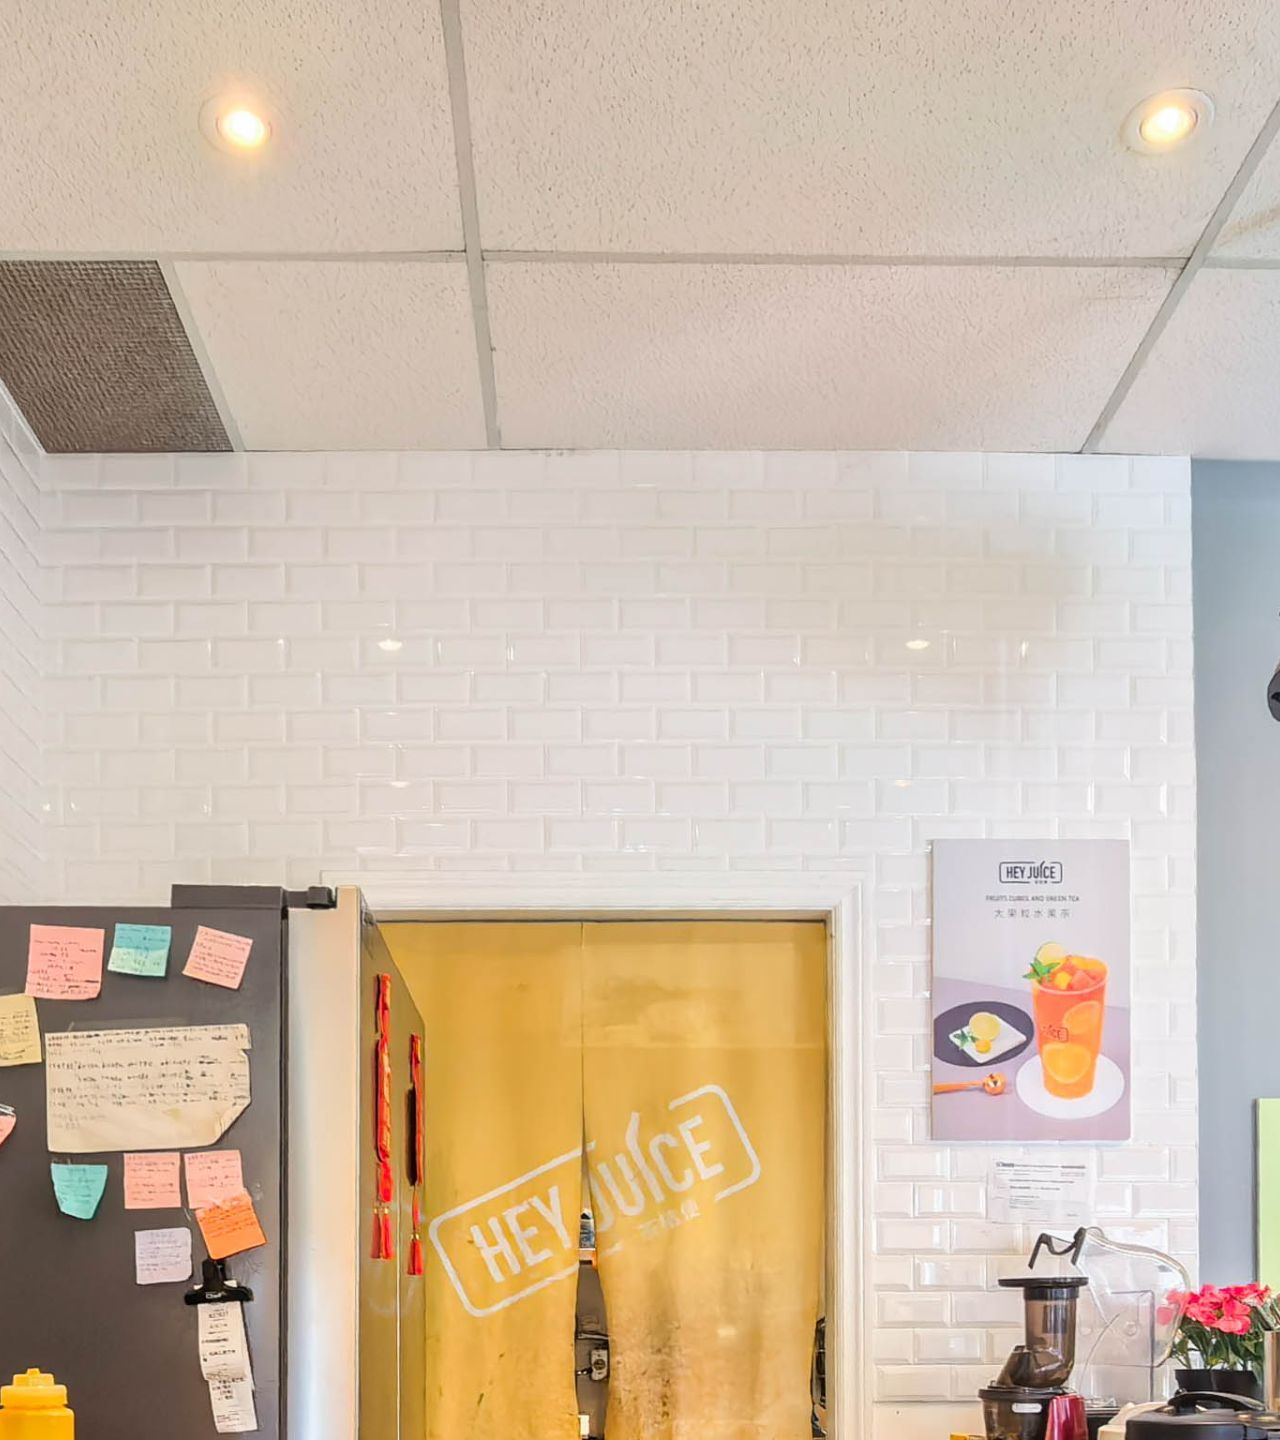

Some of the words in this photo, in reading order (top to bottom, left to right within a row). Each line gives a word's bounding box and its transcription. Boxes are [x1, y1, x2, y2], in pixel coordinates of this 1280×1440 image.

[1006, 866, 1026, 879] HEY
[1027, 860, 1056, 879] JUICE
[469, 1185, 571, 1284] HEY
[591, 1111, 724, 1233] JUICE
